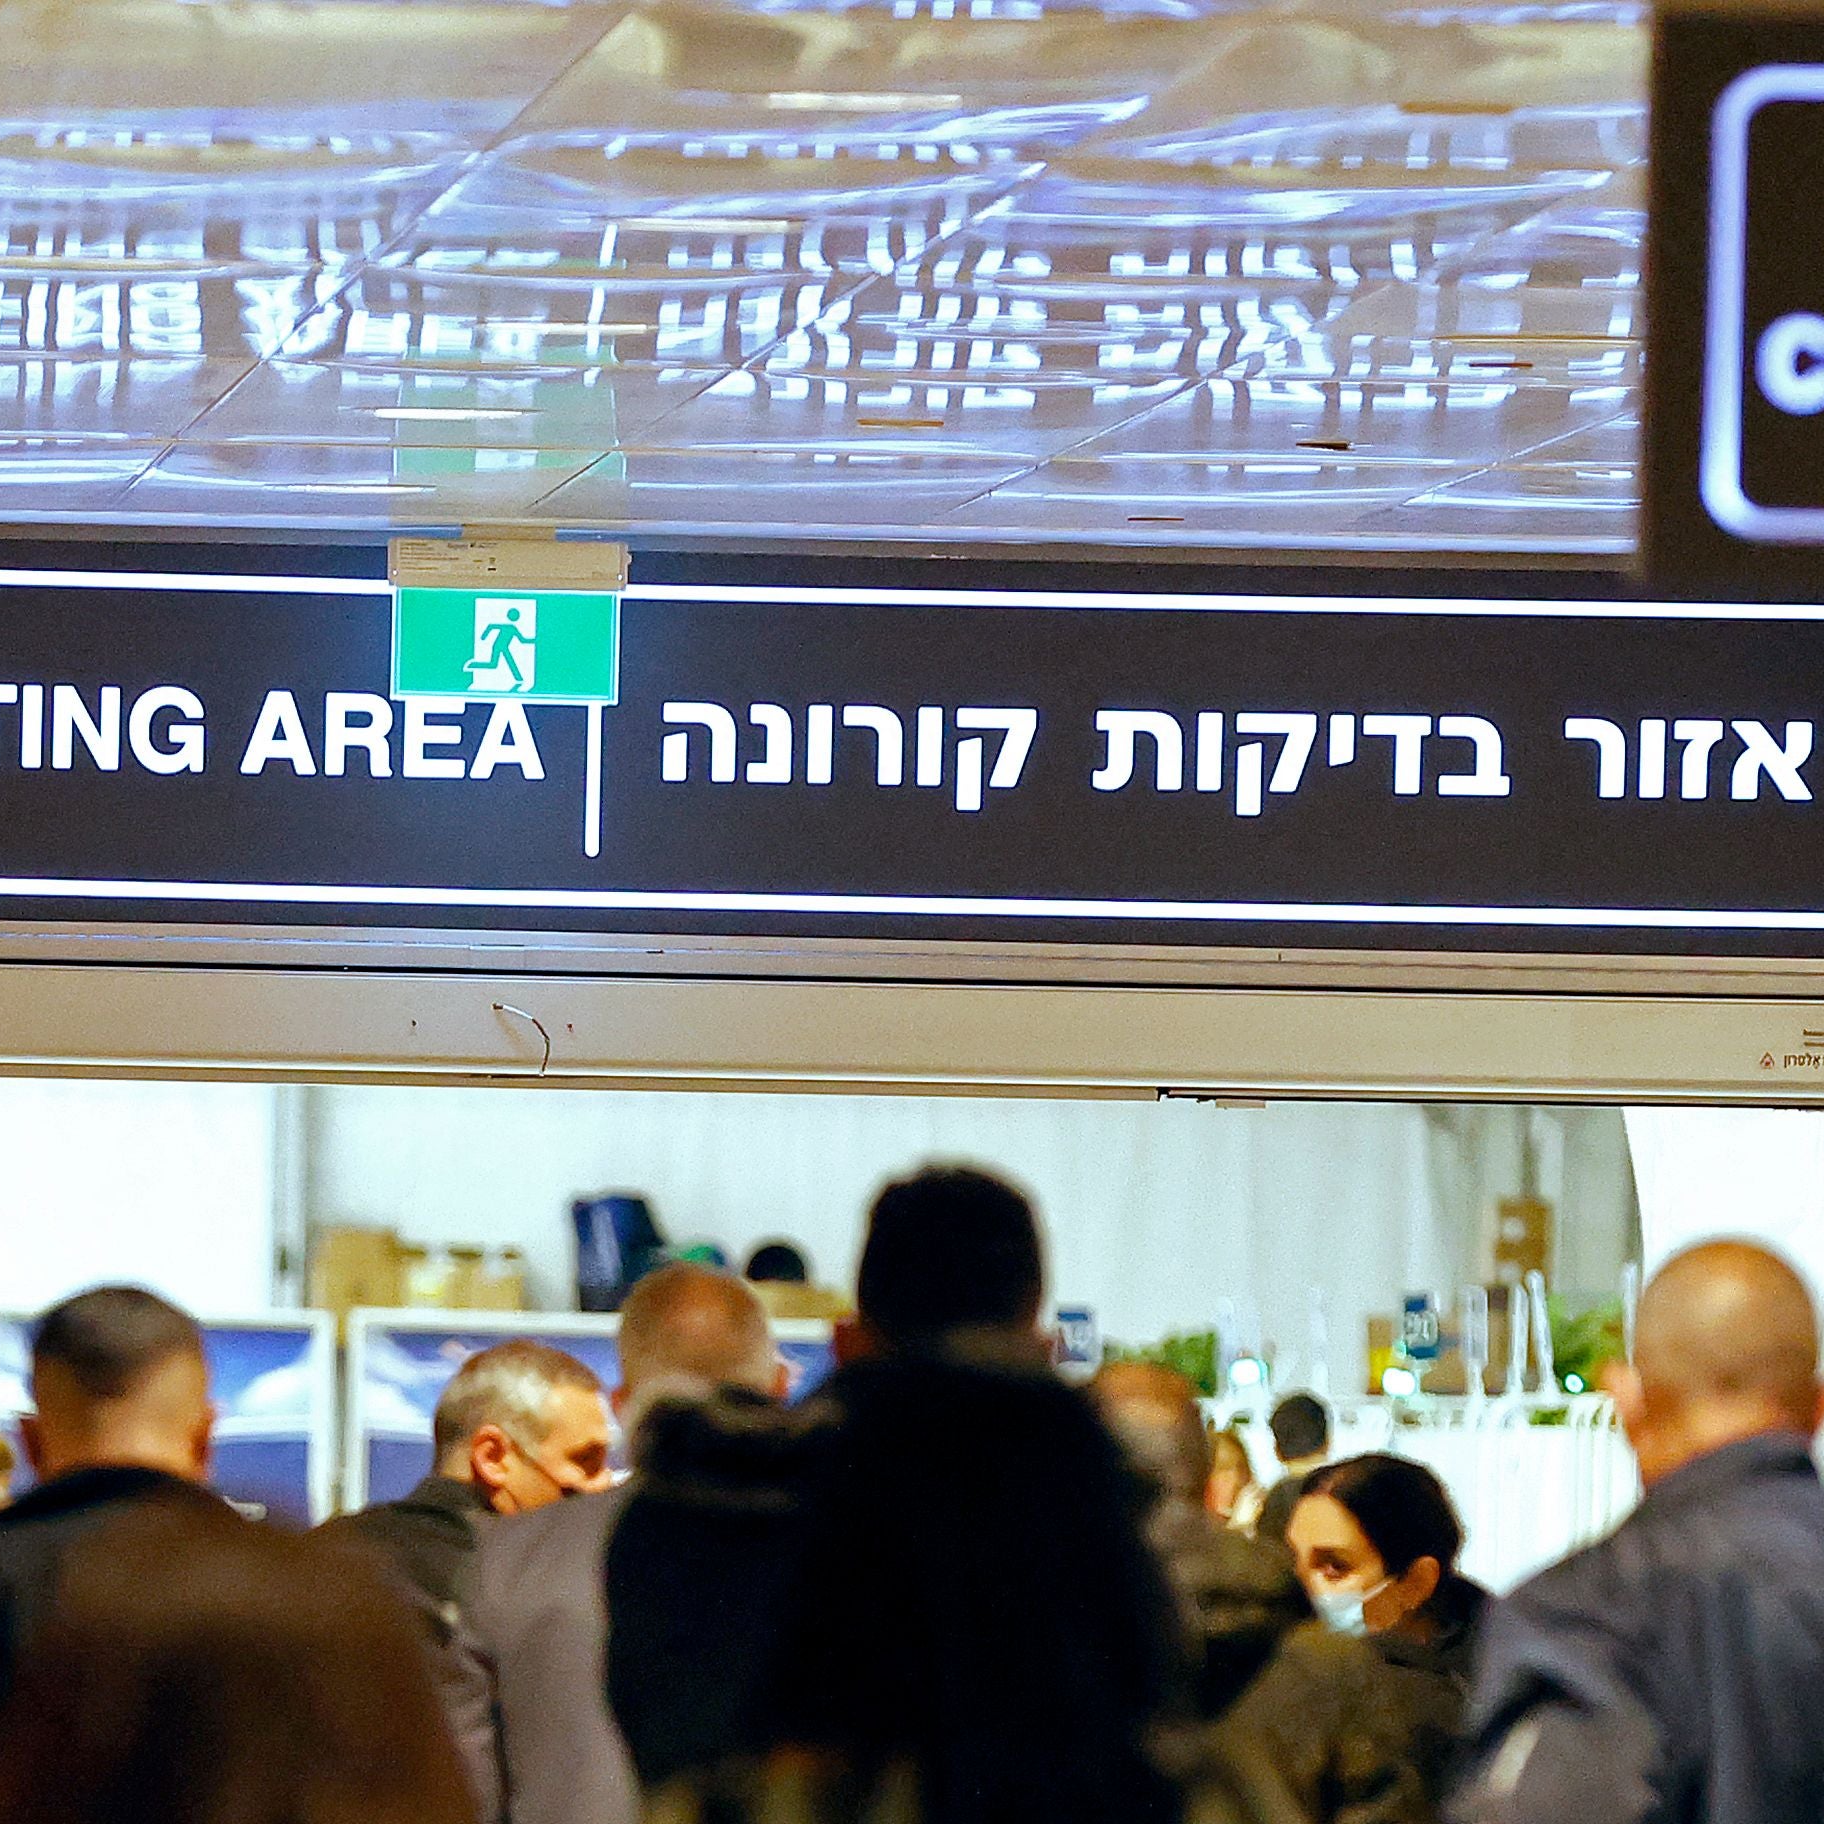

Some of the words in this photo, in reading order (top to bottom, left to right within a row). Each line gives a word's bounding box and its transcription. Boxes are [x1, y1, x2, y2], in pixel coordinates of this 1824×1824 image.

[240, 690, 545, 780] AREA
[663, 701, 1037, 811] קורונה
[1092, 710, 1510, 816] בדיקות
[1565, 718, 1813, 801] אזור
